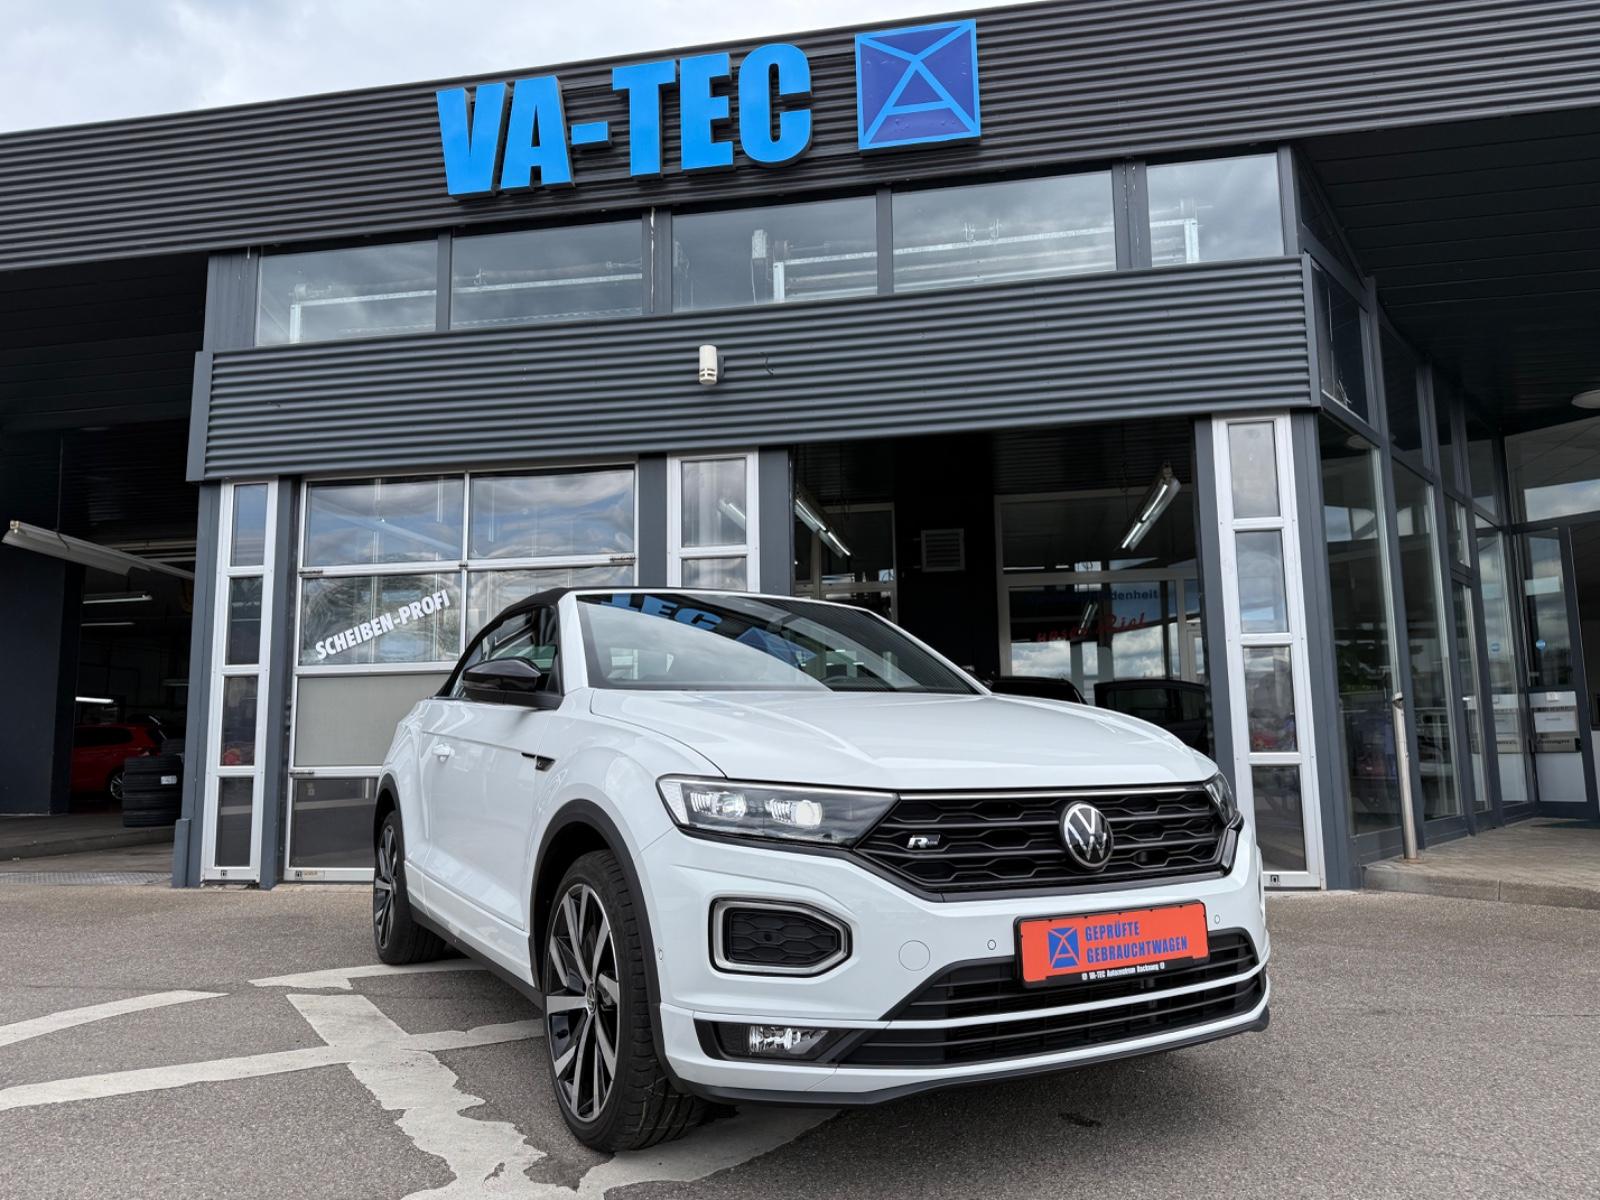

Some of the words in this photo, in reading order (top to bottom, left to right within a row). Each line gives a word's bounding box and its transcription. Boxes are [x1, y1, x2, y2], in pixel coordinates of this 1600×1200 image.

[436, 43, 812, 197] VA-TEC
[315, 589, 451, 660] SCHEIBEN-PROFI
[1085, 920, 1140, 942] GEPRÜFTE
[1087, 936, 1188, 963] GEBRAUCHTWAGEN
